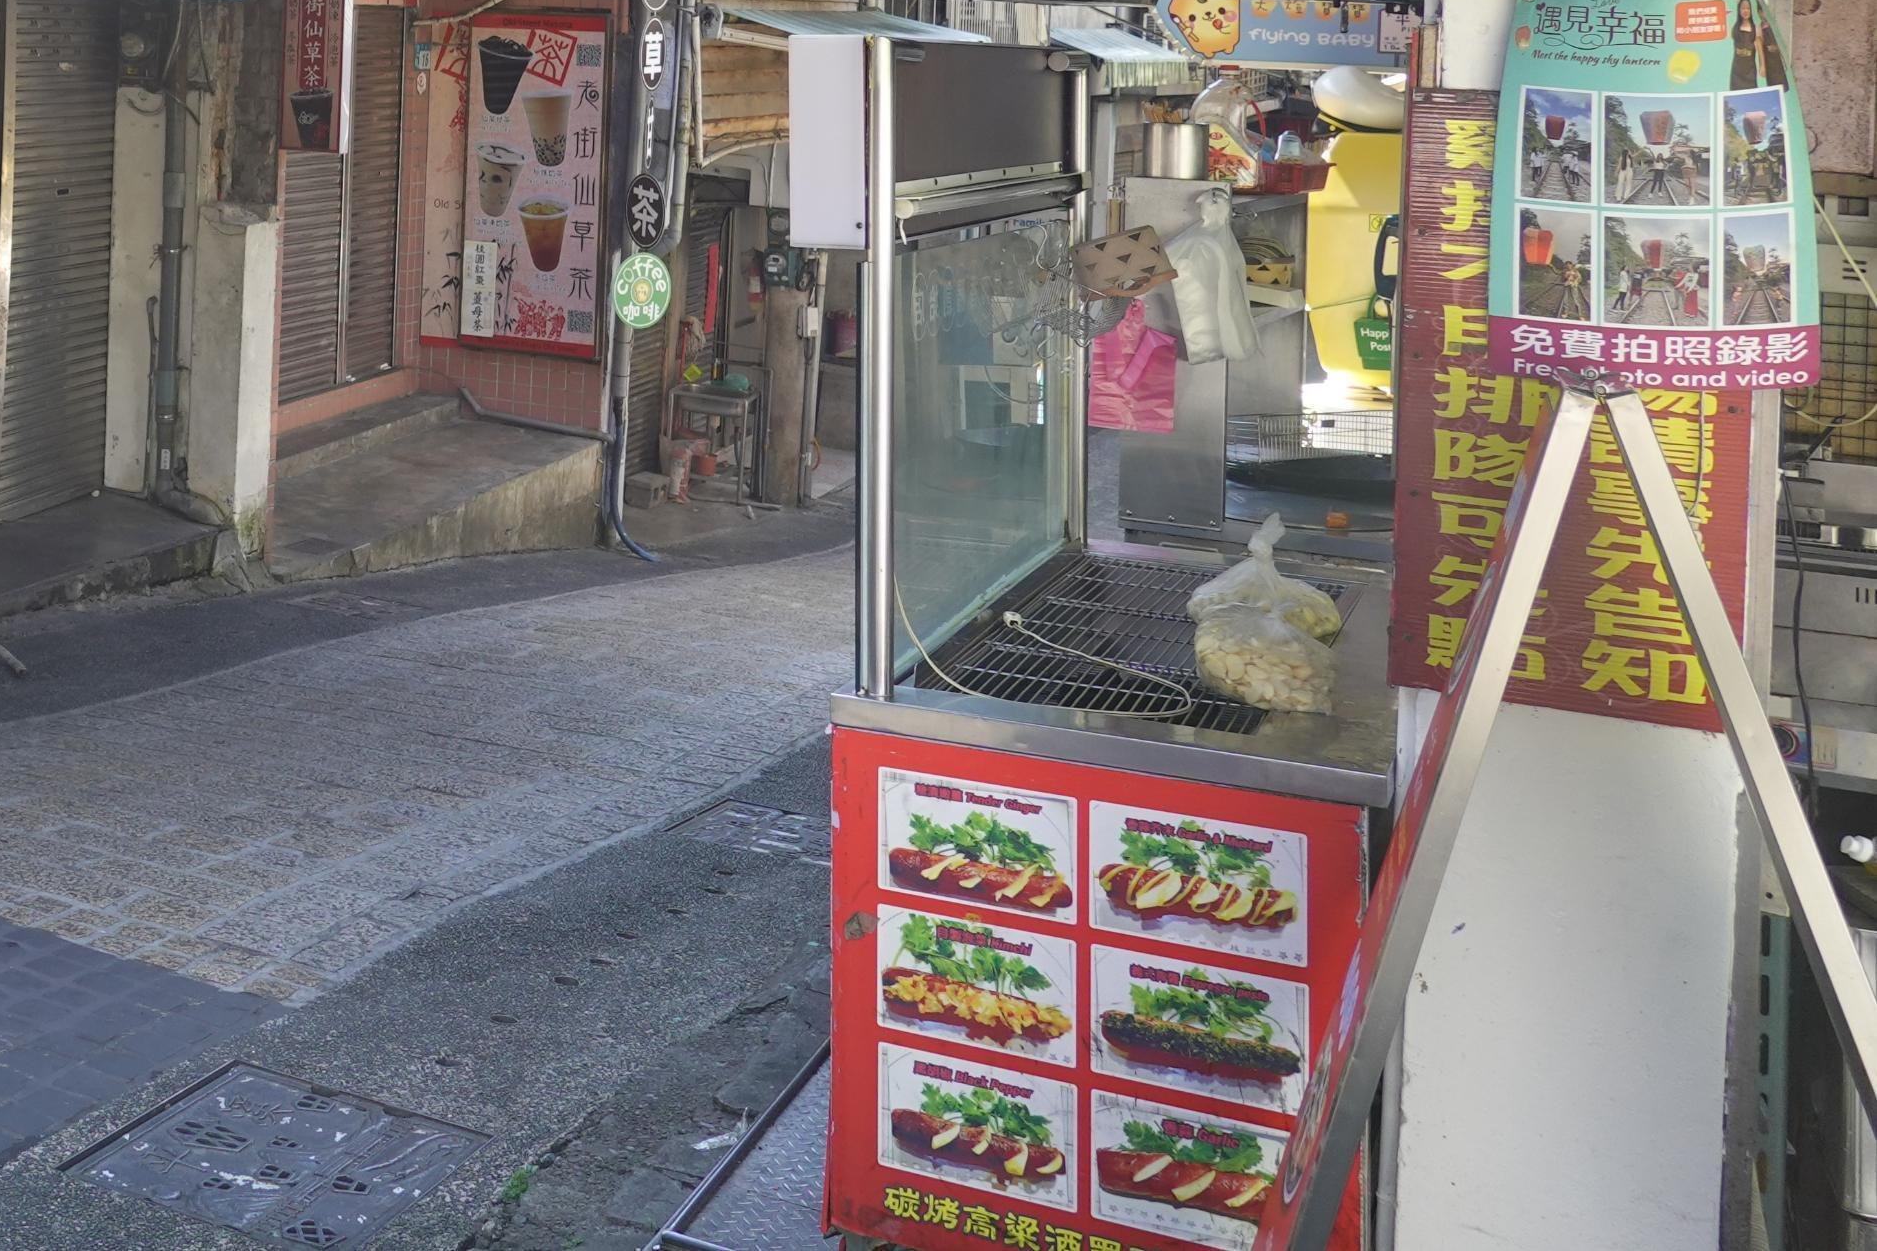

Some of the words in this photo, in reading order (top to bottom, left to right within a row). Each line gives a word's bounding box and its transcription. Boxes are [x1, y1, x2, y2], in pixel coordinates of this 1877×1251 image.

[1533, 5, 1666, 46] 遇見幸福
[1554, 51, 1569, 62] the
[1570, 51, 1600, 67] happy
[1601, 53, 1620, 67] sky
[1622, 54, 1662, 66] lantern
[567, 79, 600, 300] 老街仙草茶
[630, 184, 660, 238] 茶
[623, 301, 660, 321] 咖啡
[1510, 324, 1808, 367] 免費拍照錄影
[1672, 370, 1726, 387] and
[1735, 369, 1809, 387] video
[965, 791, 1004, 809] Tender
[1004, 798, 1043, 816] Ginger
[1222, 834, 1274, 854] Mustard
[989, 935, 1034, 957] Kimchi
[953, 1070, 989, 1090] Black
[989, 1077, 1034, 1100] Pepper
[1196, 1127, 1241, 1149] Garlic
